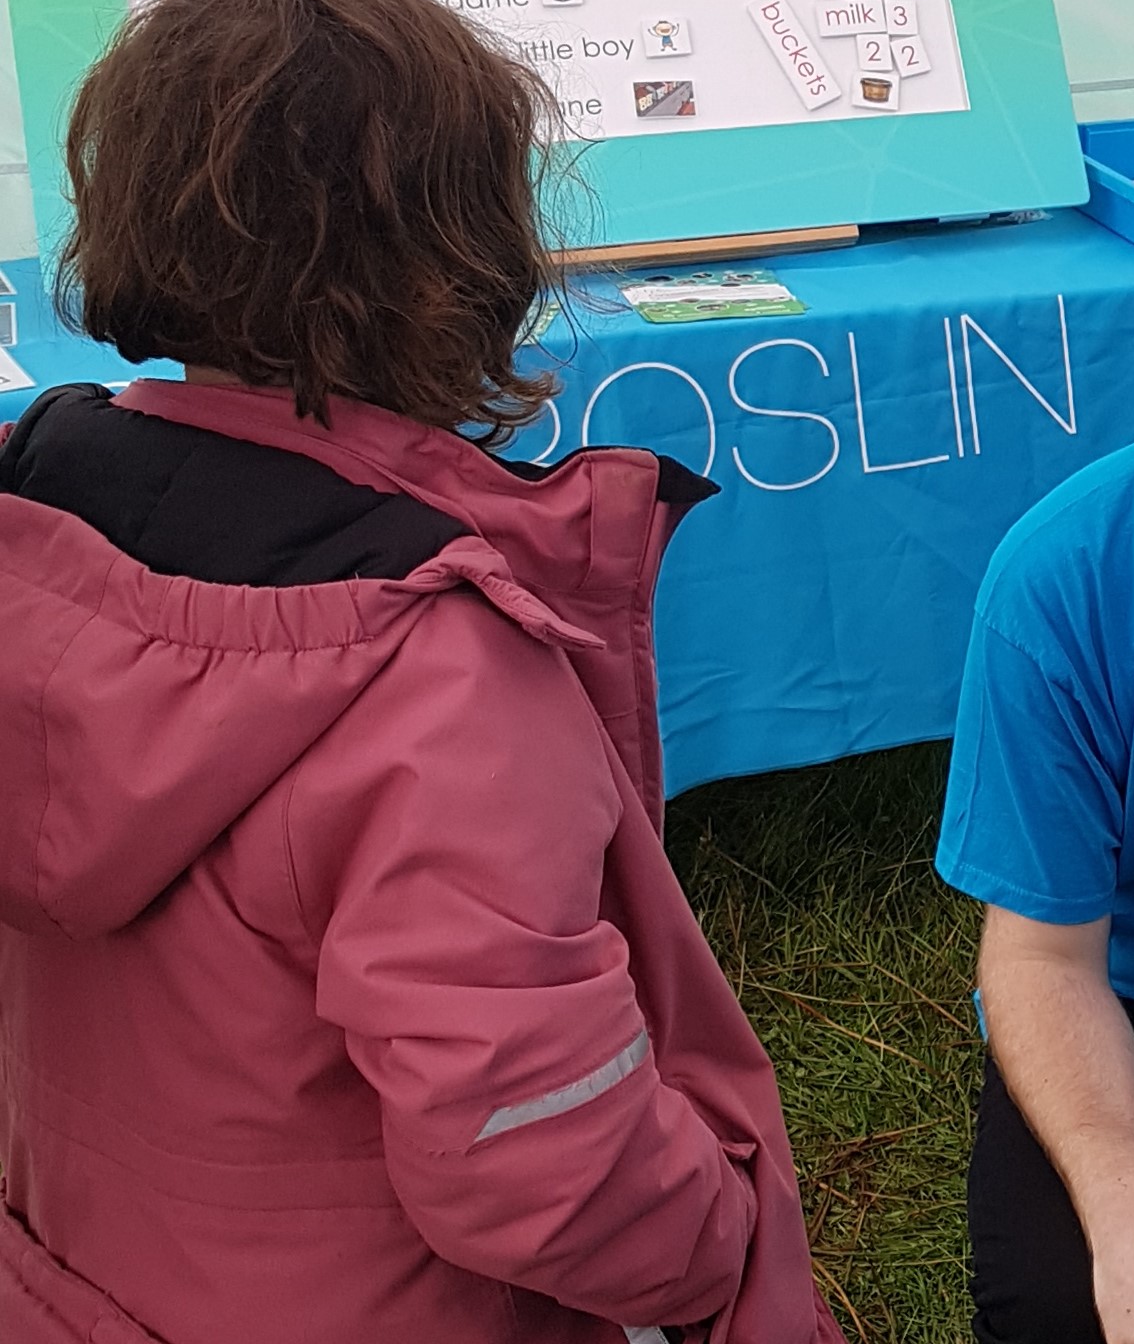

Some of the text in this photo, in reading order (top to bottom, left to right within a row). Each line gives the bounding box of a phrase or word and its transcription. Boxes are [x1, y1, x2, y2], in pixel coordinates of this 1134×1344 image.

[825, 4, 908, 27] milk 3
[582, 38, 634, 60] boy
[760, 1, 826, 97] buckets
[866, 42, 919, 66] 2 2
